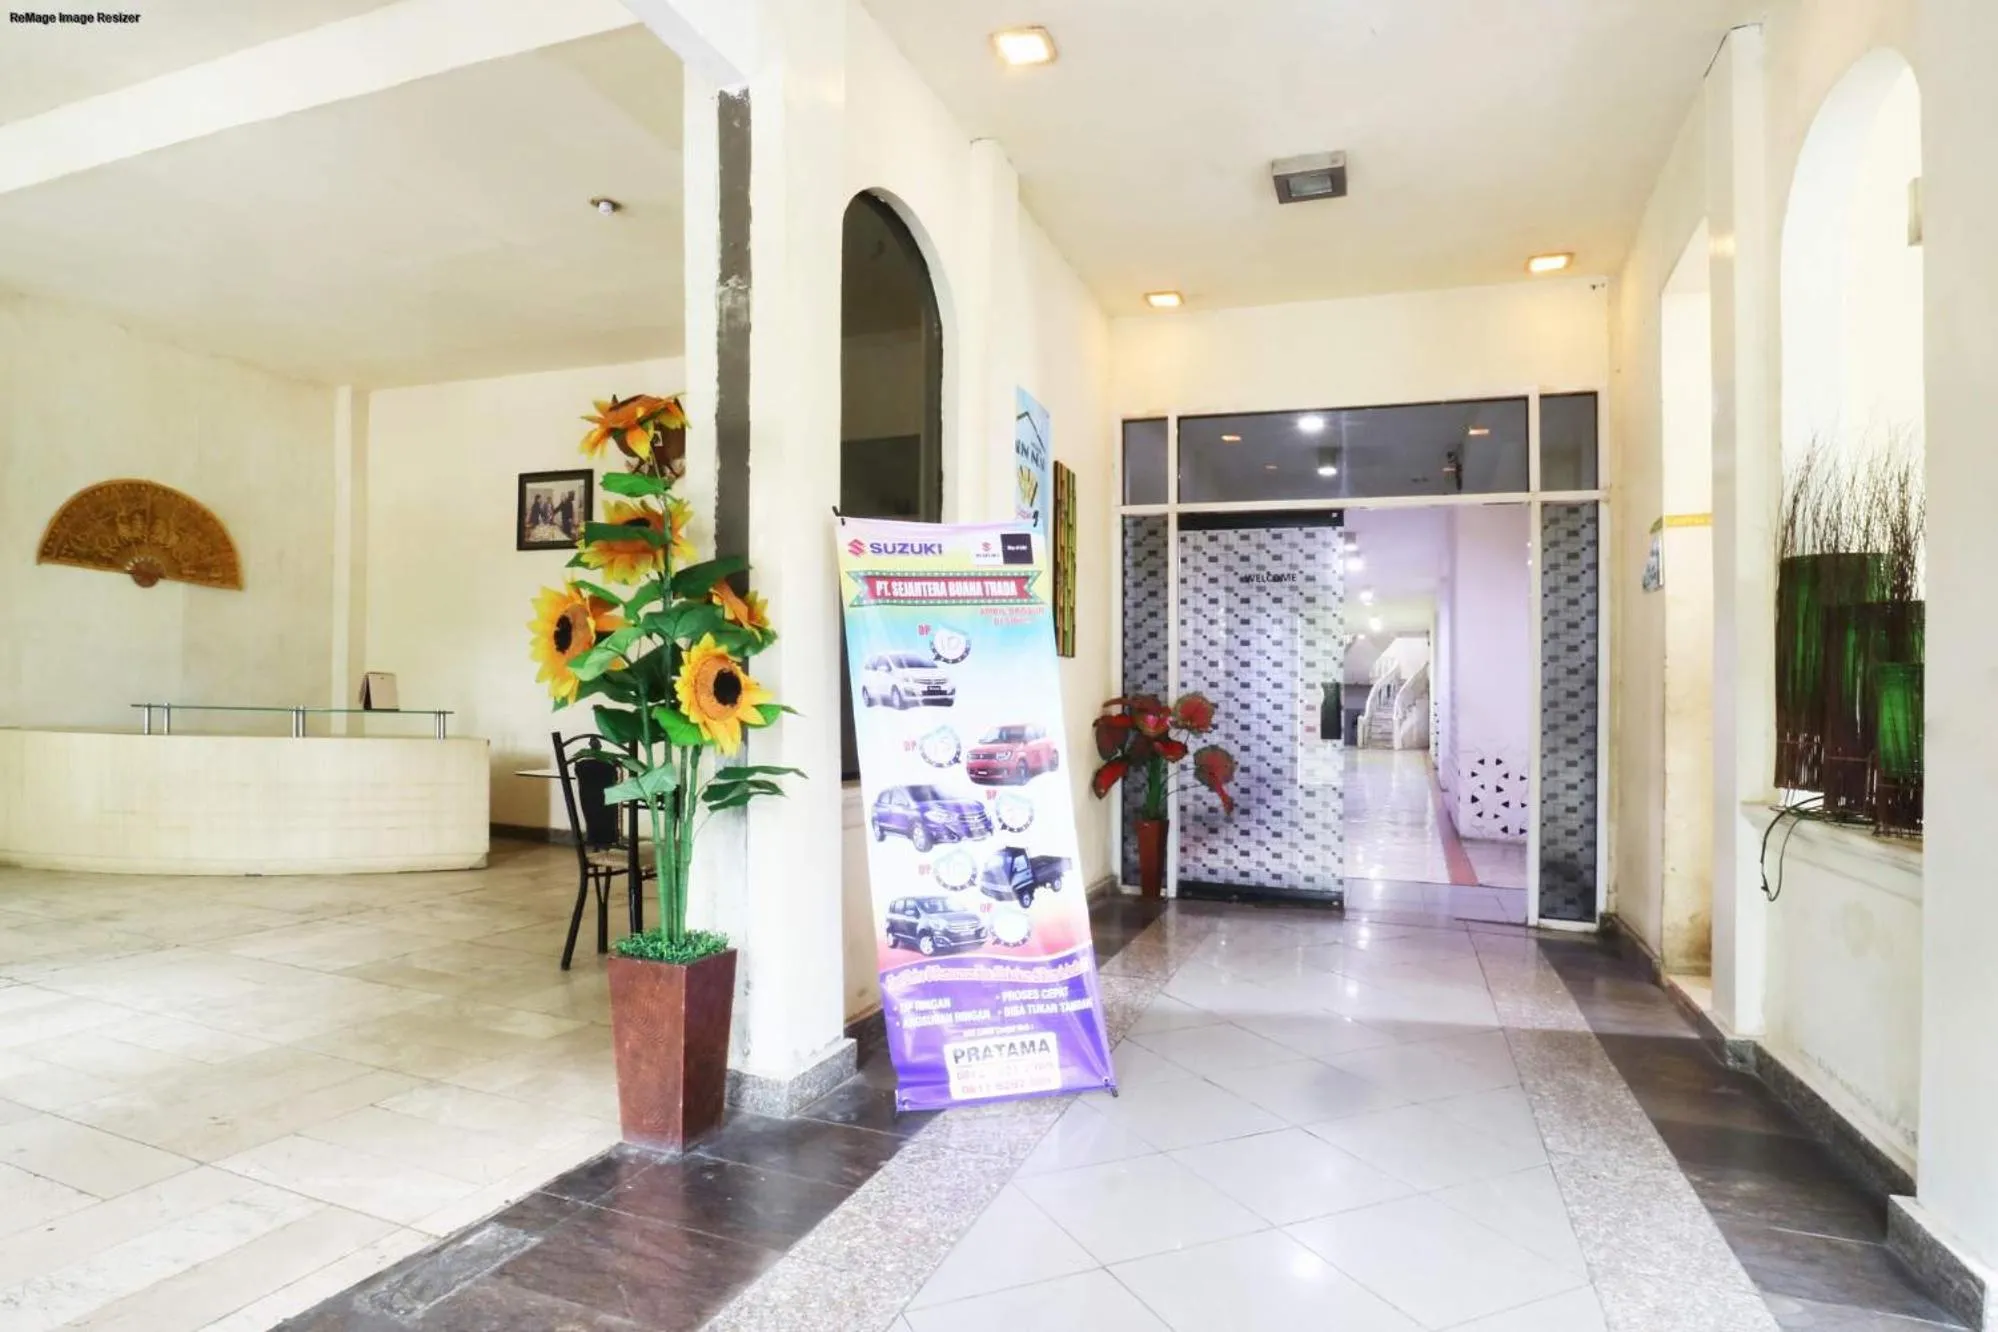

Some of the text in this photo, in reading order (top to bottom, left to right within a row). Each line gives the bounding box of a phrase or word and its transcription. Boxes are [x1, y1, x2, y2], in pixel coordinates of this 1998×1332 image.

[869, 542, 943, 556] SUZUKI
[1245, 573, 1297, 582] WELCOME
[875, 580, 890, 597] PT.
[952, 1038, 1051, 1065] PRATAMA
